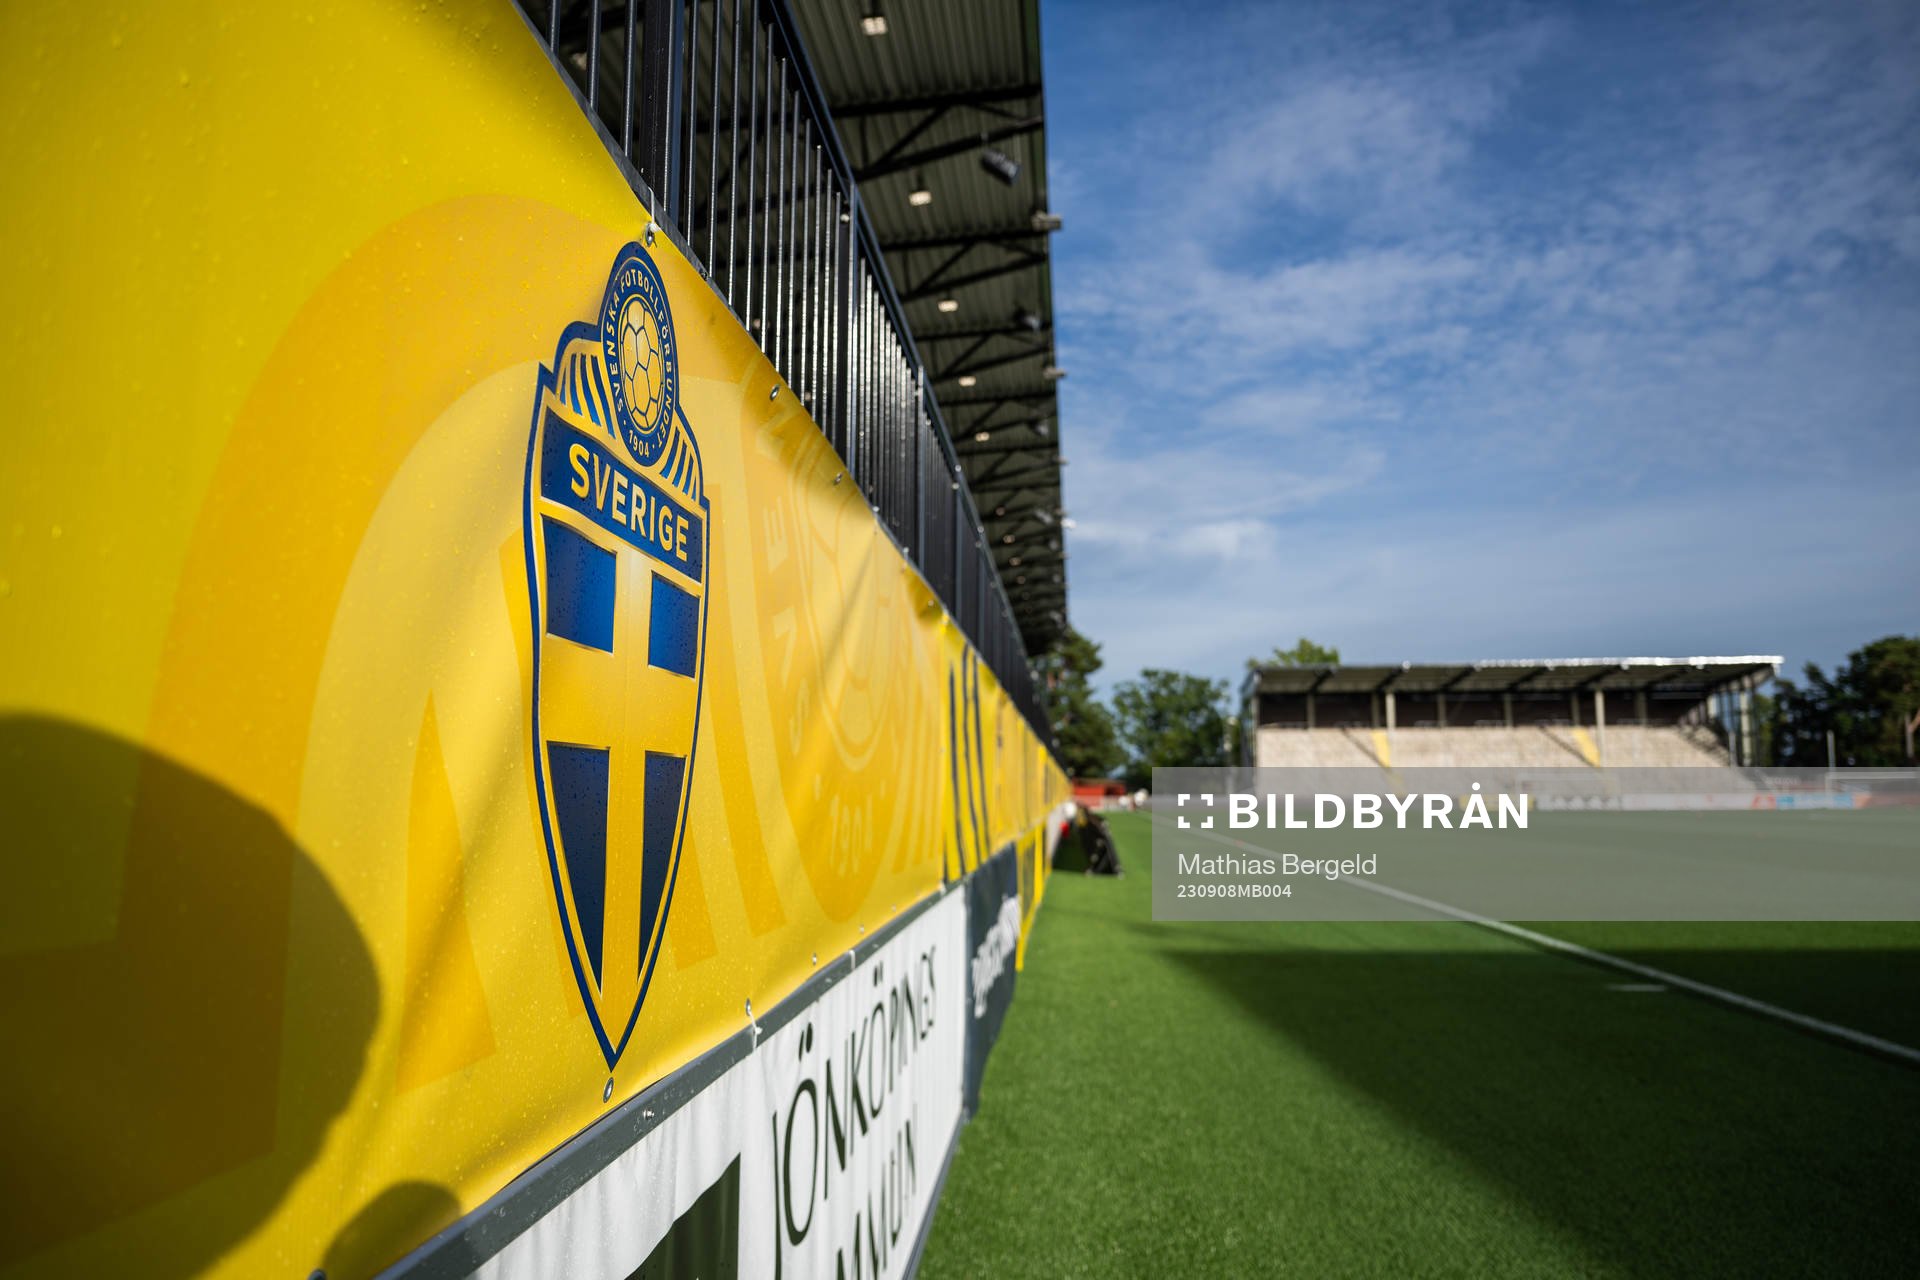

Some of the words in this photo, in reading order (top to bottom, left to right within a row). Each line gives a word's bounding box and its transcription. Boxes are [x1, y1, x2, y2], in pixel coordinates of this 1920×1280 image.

[606, 291, 624, 412] SVENSKA
[620, 269, 673, 448] FOTBOLLFÖRBUNDET
[568, 443, 690, 561] SVERIGE
[629, 430, 649, 457] 1904
